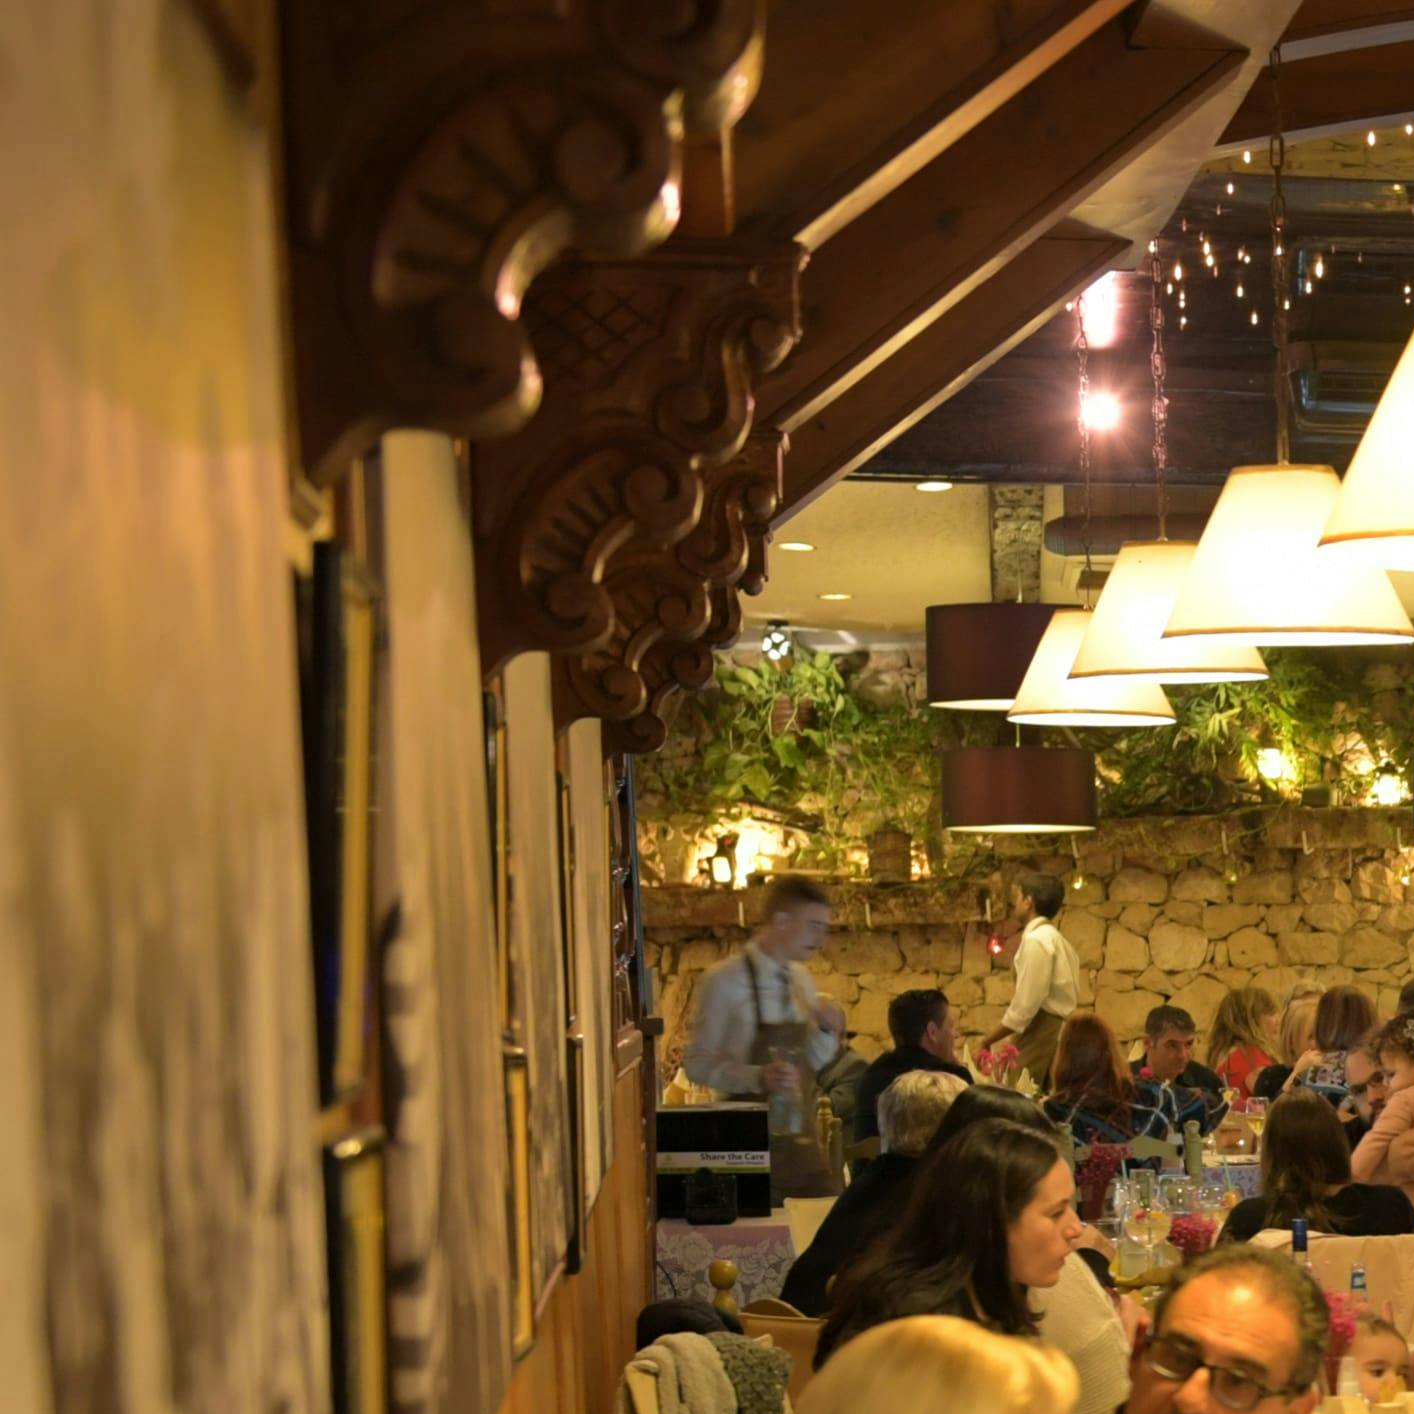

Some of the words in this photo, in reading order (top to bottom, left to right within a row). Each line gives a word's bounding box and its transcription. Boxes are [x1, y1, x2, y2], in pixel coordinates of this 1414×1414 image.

[700, 1152, 726, 1161] Share
[727, 1152, 742, 1161] the
[744, 1152, 764, 1161] Care
